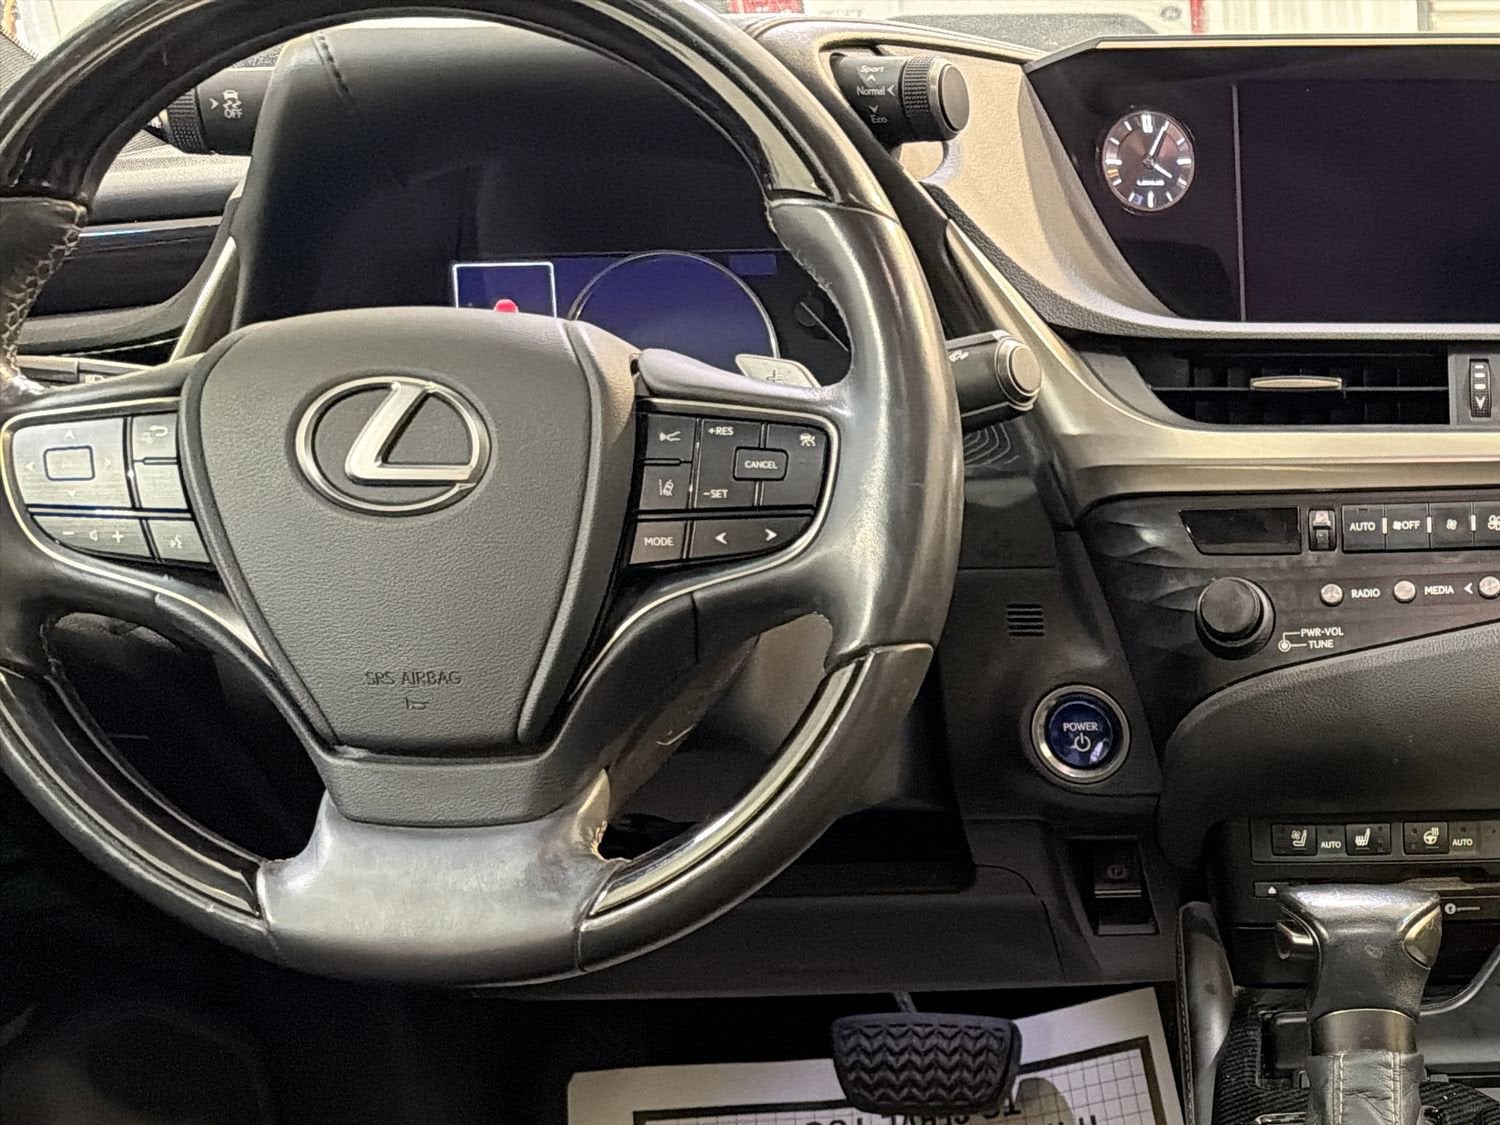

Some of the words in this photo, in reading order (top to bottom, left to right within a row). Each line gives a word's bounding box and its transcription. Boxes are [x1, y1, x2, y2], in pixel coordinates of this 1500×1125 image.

[860, 65, 885, 73] Sport
[857, 86, 885, 96] Normal
[224, 109, 243, 118] OFF
[870, 115, 888, 123] Eco
[745, 461, 778, 469] CANCEL
[1350, 522, 1376, 532] AUTO
[1402, 520, 1420, 530] OFF
[644, 536, 674, 546] MODE
[1352, 588, 1381, 599] RADIO
[1424, 585, 1454, 596] MEDIA
[1308, 640, 1334, 649] TUNE
[400, 671, 462, 686] AIRBAG
[1062, 722, 1098, 732] POWER
[1320, 841, 1342, 849] AUTO
[1452, 838, 1473, 846] AUTO
